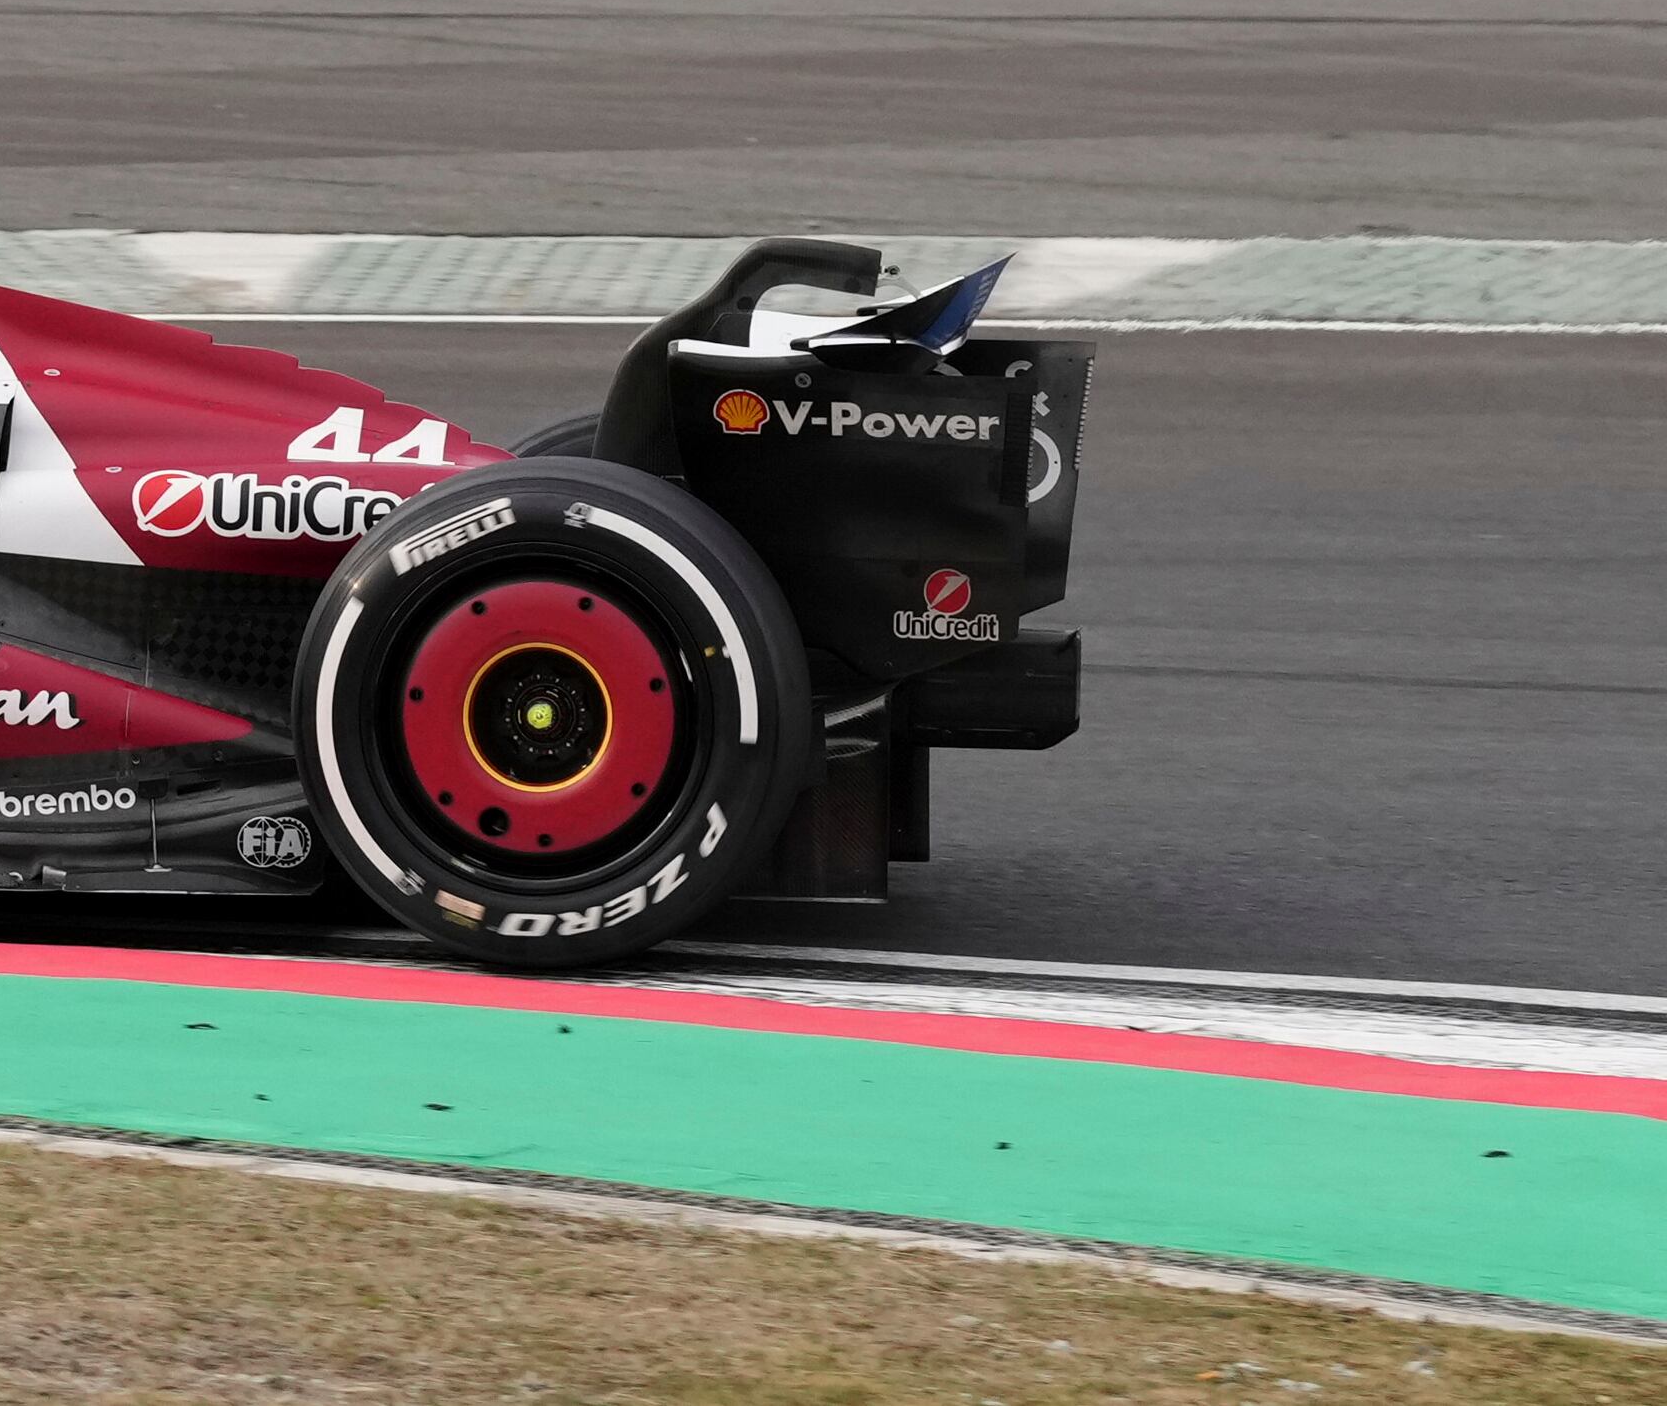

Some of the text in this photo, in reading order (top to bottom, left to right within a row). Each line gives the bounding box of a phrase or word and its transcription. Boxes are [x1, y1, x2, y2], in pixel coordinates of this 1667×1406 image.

[287, 406, 456, 466] 44
[773, 399, 1000, 441] V-Power
[389, 497, 517, 578] PIRELLI
[893, 610, 999, 642] UniCredit
[698, 801, 728, 859] P
[496, 853, 691, 938] ZERO
